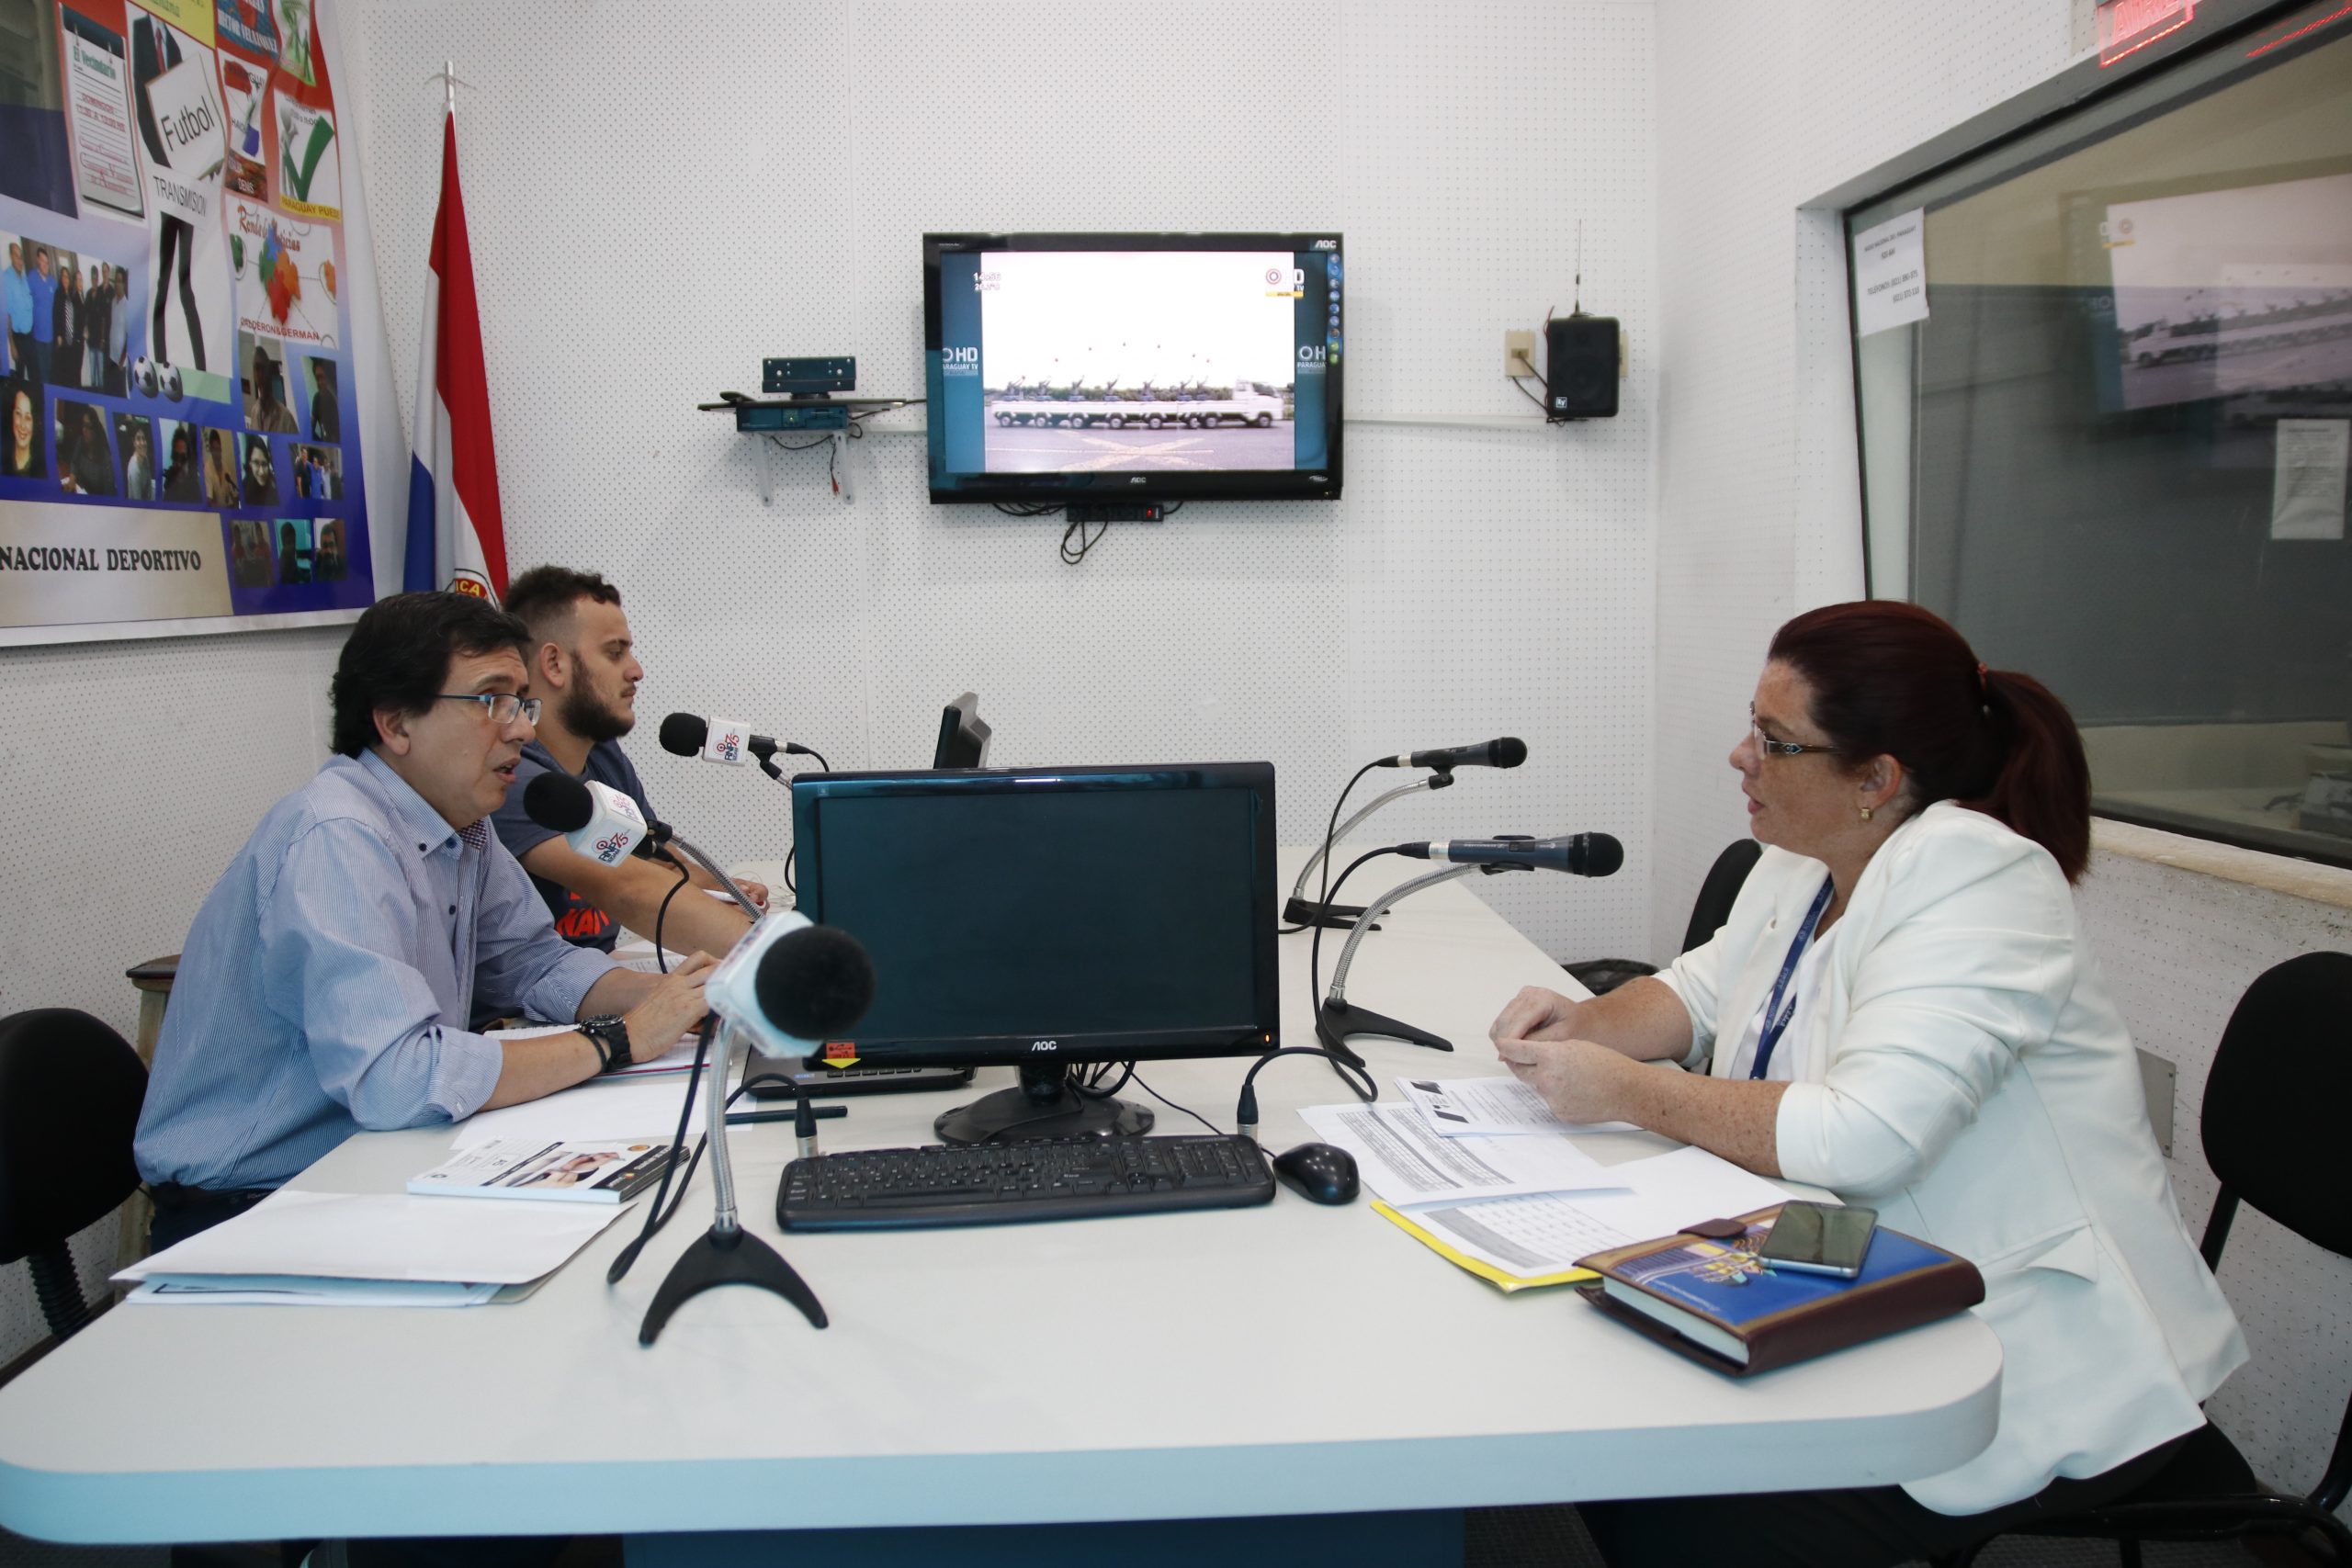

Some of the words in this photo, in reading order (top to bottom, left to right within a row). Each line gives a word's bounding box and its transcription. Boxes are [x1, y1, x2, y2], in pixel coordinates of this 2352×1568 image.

[161, 95, 215, 152] Futbol
[153, 176, 207, 217] TRANSMISION
[281, 196, 316, 214] PARAGUAY
[1315, 240, 1337, 249] AOC
[956, 346, 978, 362] HD
[0, 547, 99, 571] NACIONAL
[107, 548, 201, 571] DEPORTIVO
[598, 840, 617, 863] RNP
[1032, 1040, 1057, 1052] AOC
